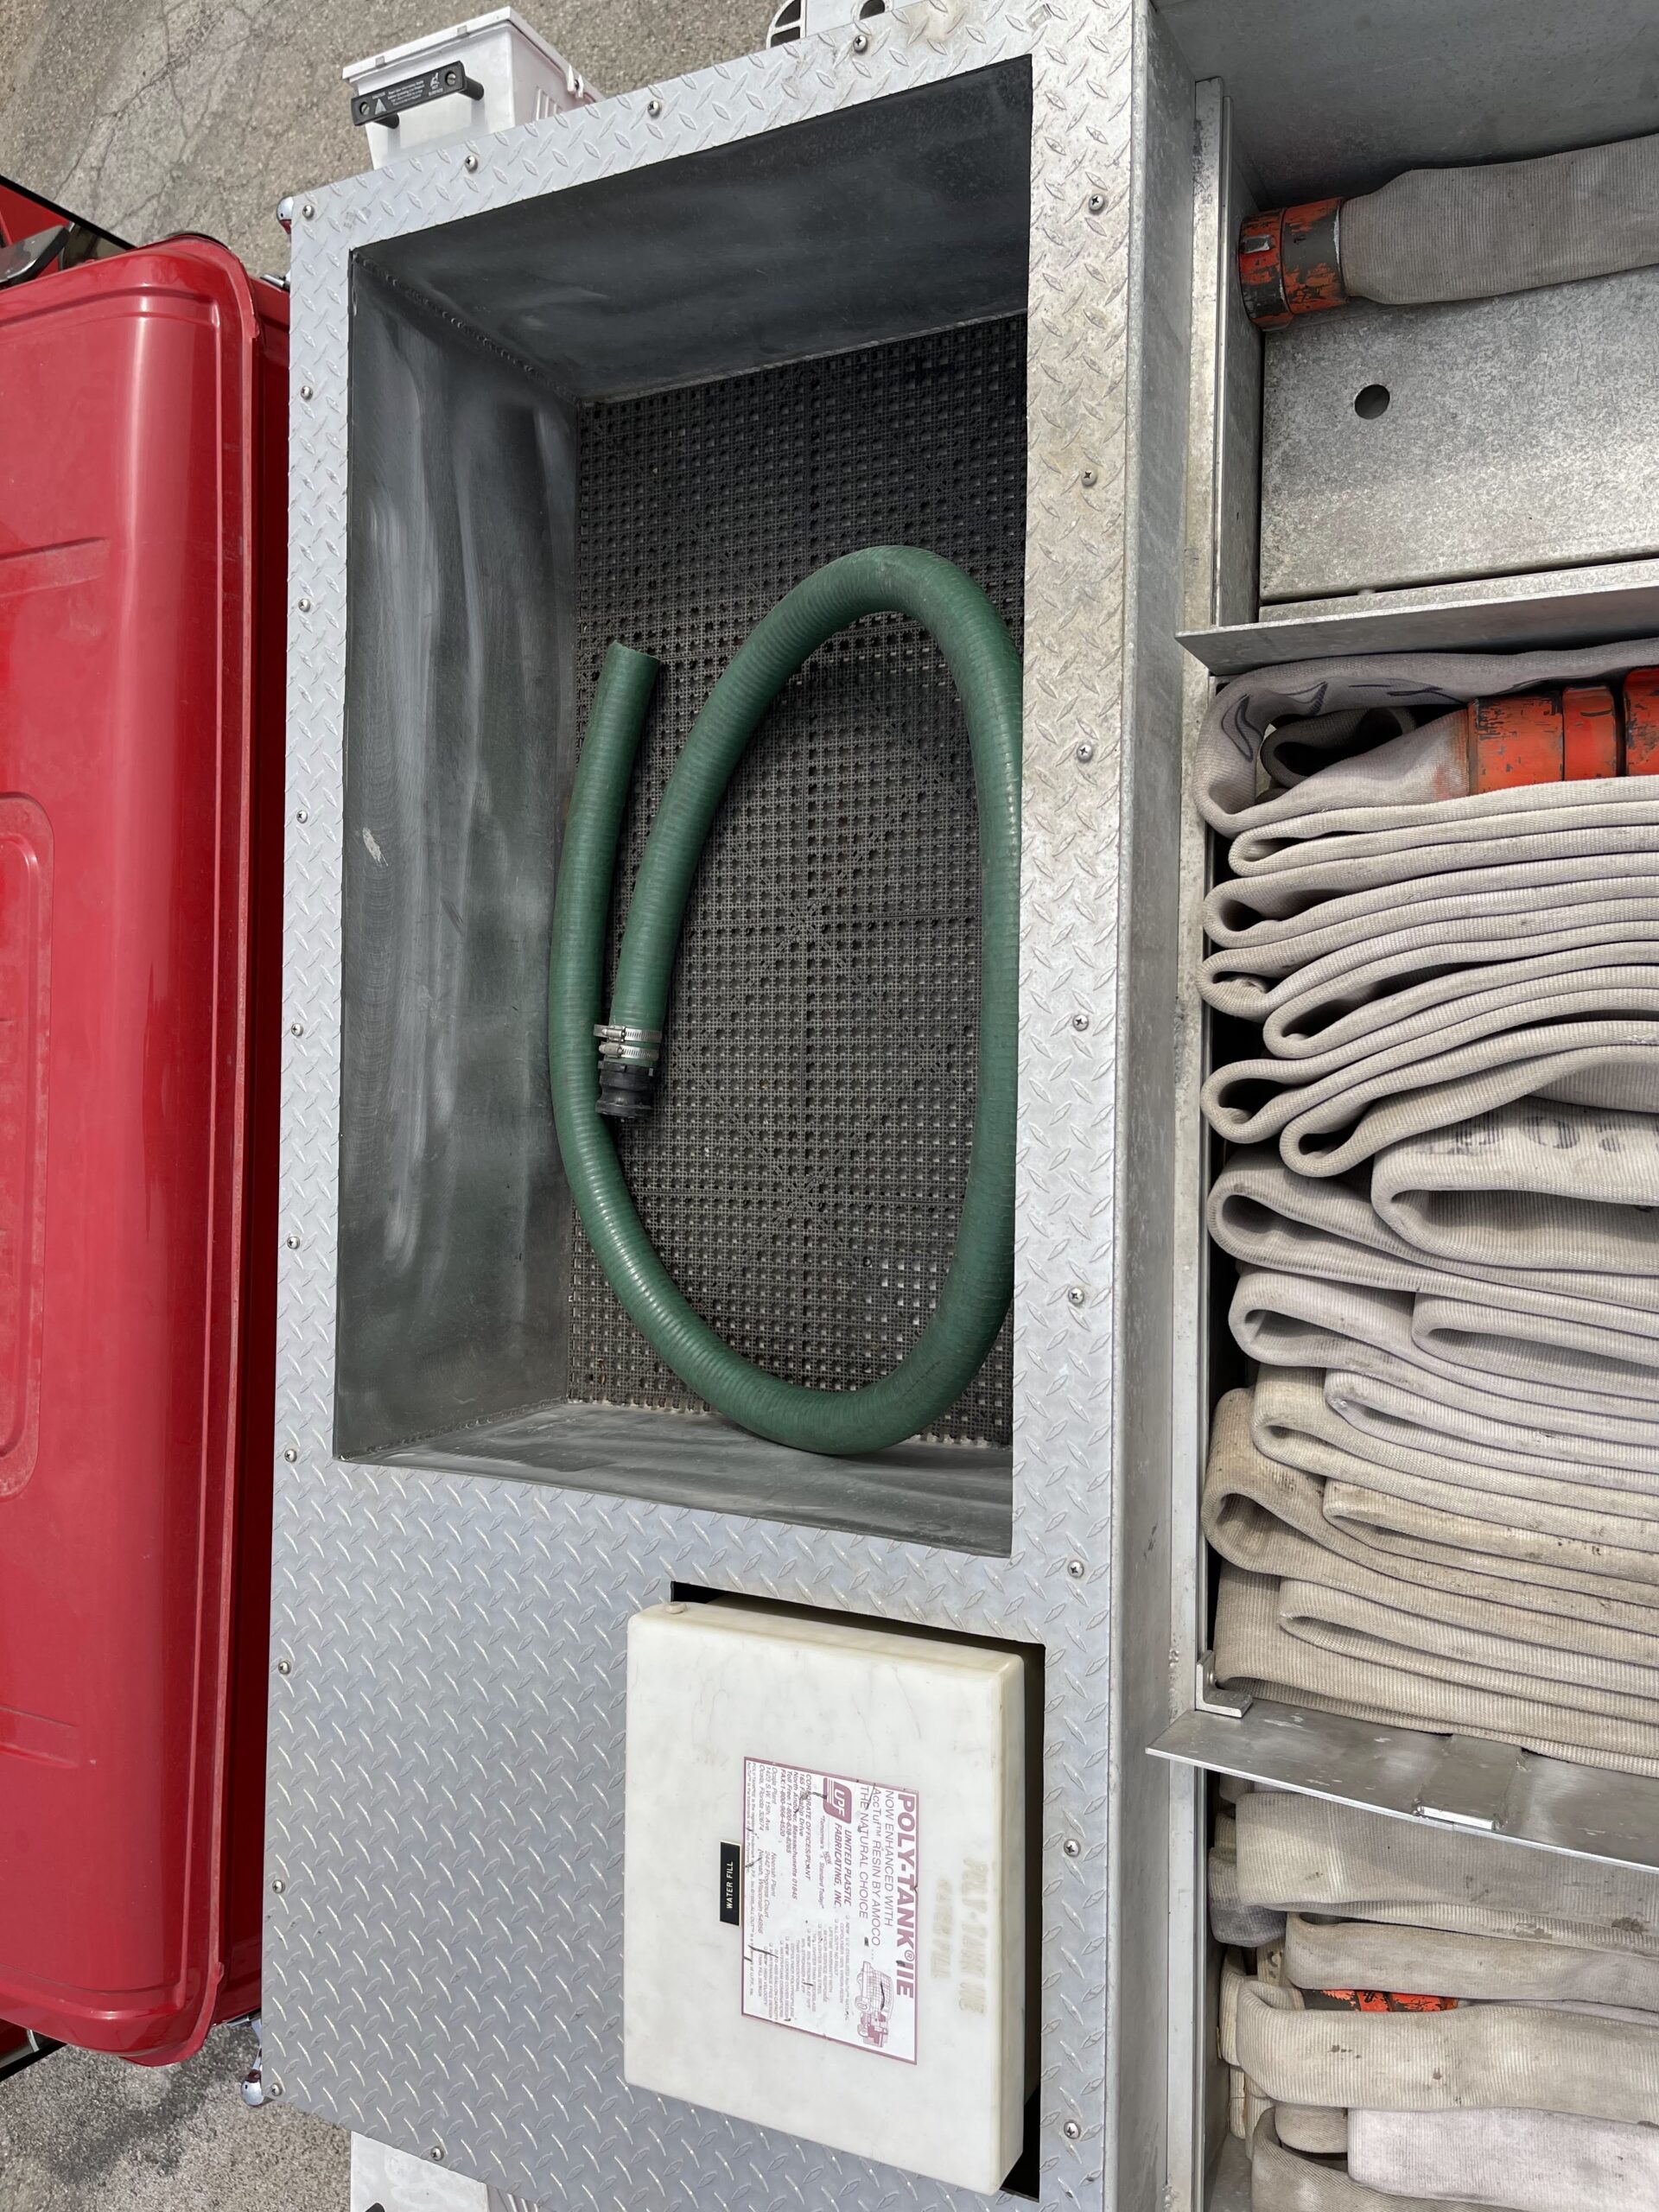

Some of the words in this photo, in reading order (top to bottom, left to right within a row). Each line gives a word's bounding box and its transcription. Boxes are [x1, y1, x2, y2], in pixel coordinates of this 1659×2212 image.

[833, 1788, 845, 1817] UPF
[861, 1784, 869, 1810] THE
[886, 1789, 894, 1821] NOW
[858, 1811, 868, 1867] NATURAL
[823, 1850, 832, 1866] NEW
[873, 1840, 881, 1878] RESIN
[885, 1823, 893, 1891] ENHANCED
[859, 1872, 868, 1918] CHOICE
[872, 1881, 880, 1898] BY
[872, 1897, 880, 1946] AMOCO
[885, 1895, 893, 1927] WITH
